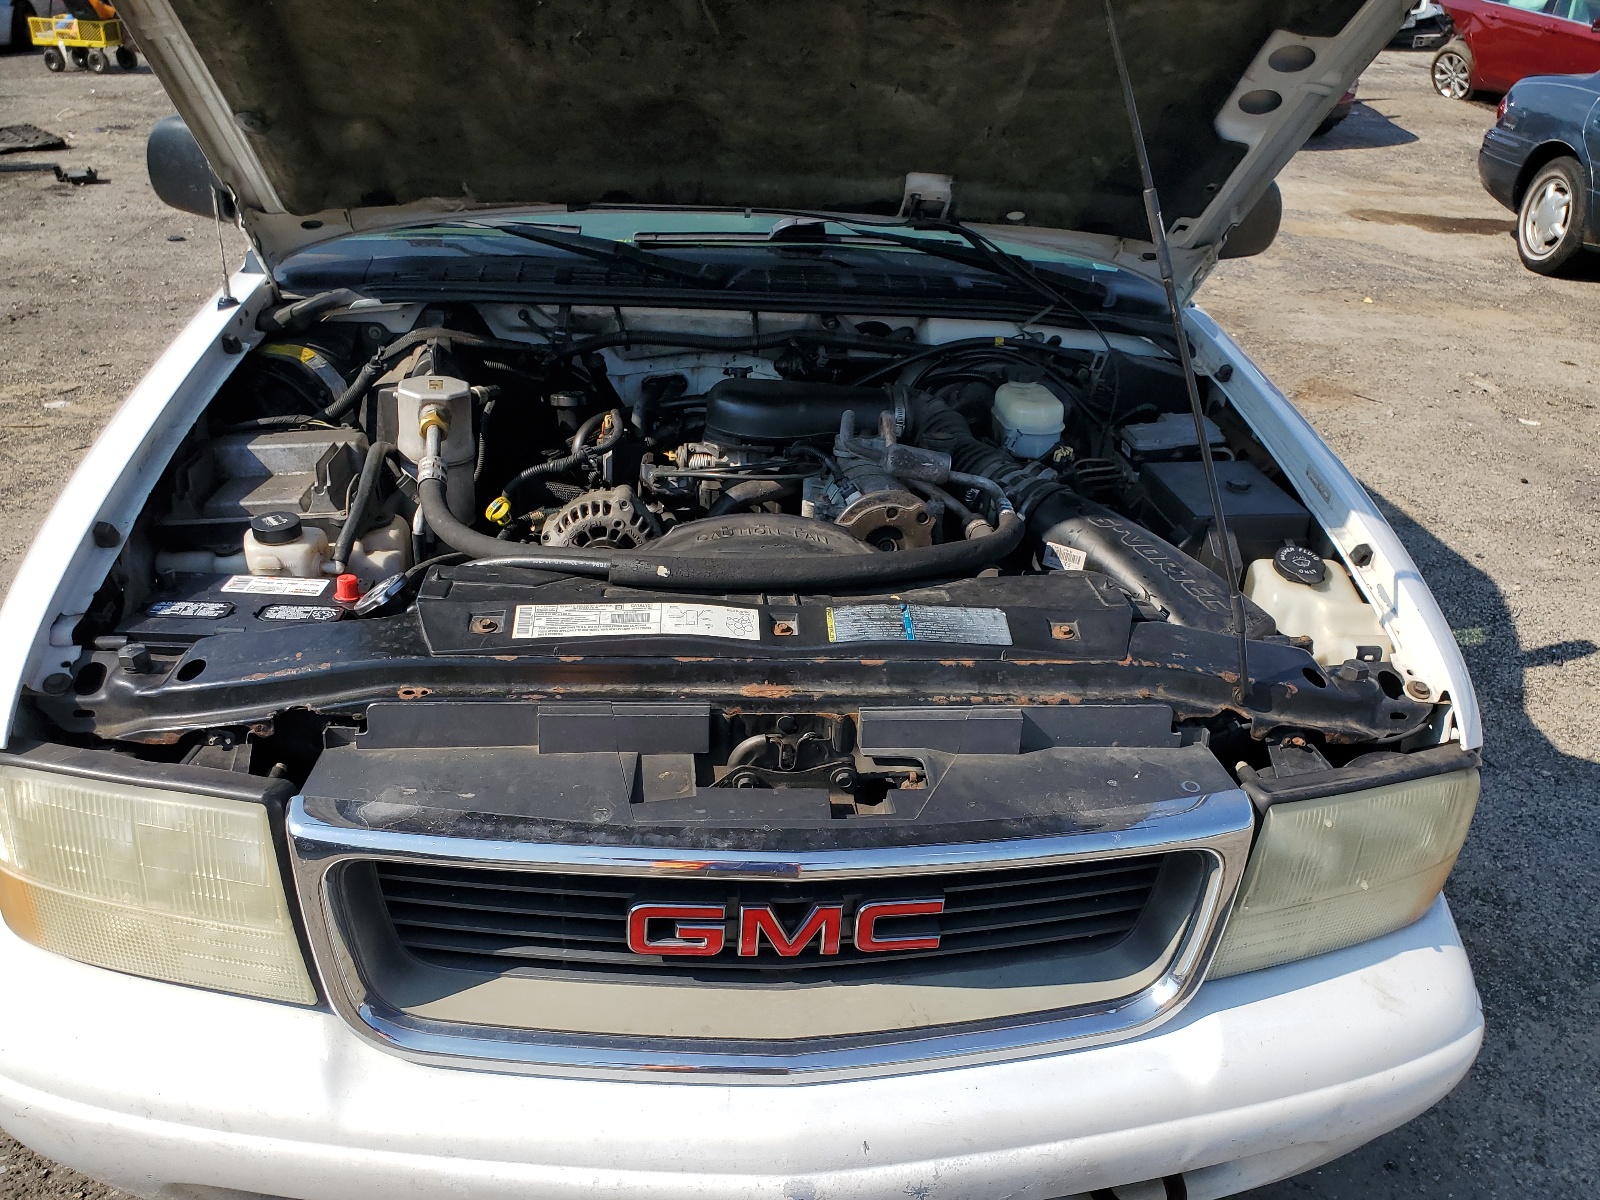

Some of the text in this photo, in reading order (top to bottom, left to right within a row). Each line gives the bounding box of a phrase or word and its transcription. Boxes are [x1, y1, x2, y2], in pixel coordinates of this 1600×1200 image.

[696, 526, 781, 543] CAUTION
[1298, 547, 1320, 562] FLUID
[627, 898, 946, 957] GMC
